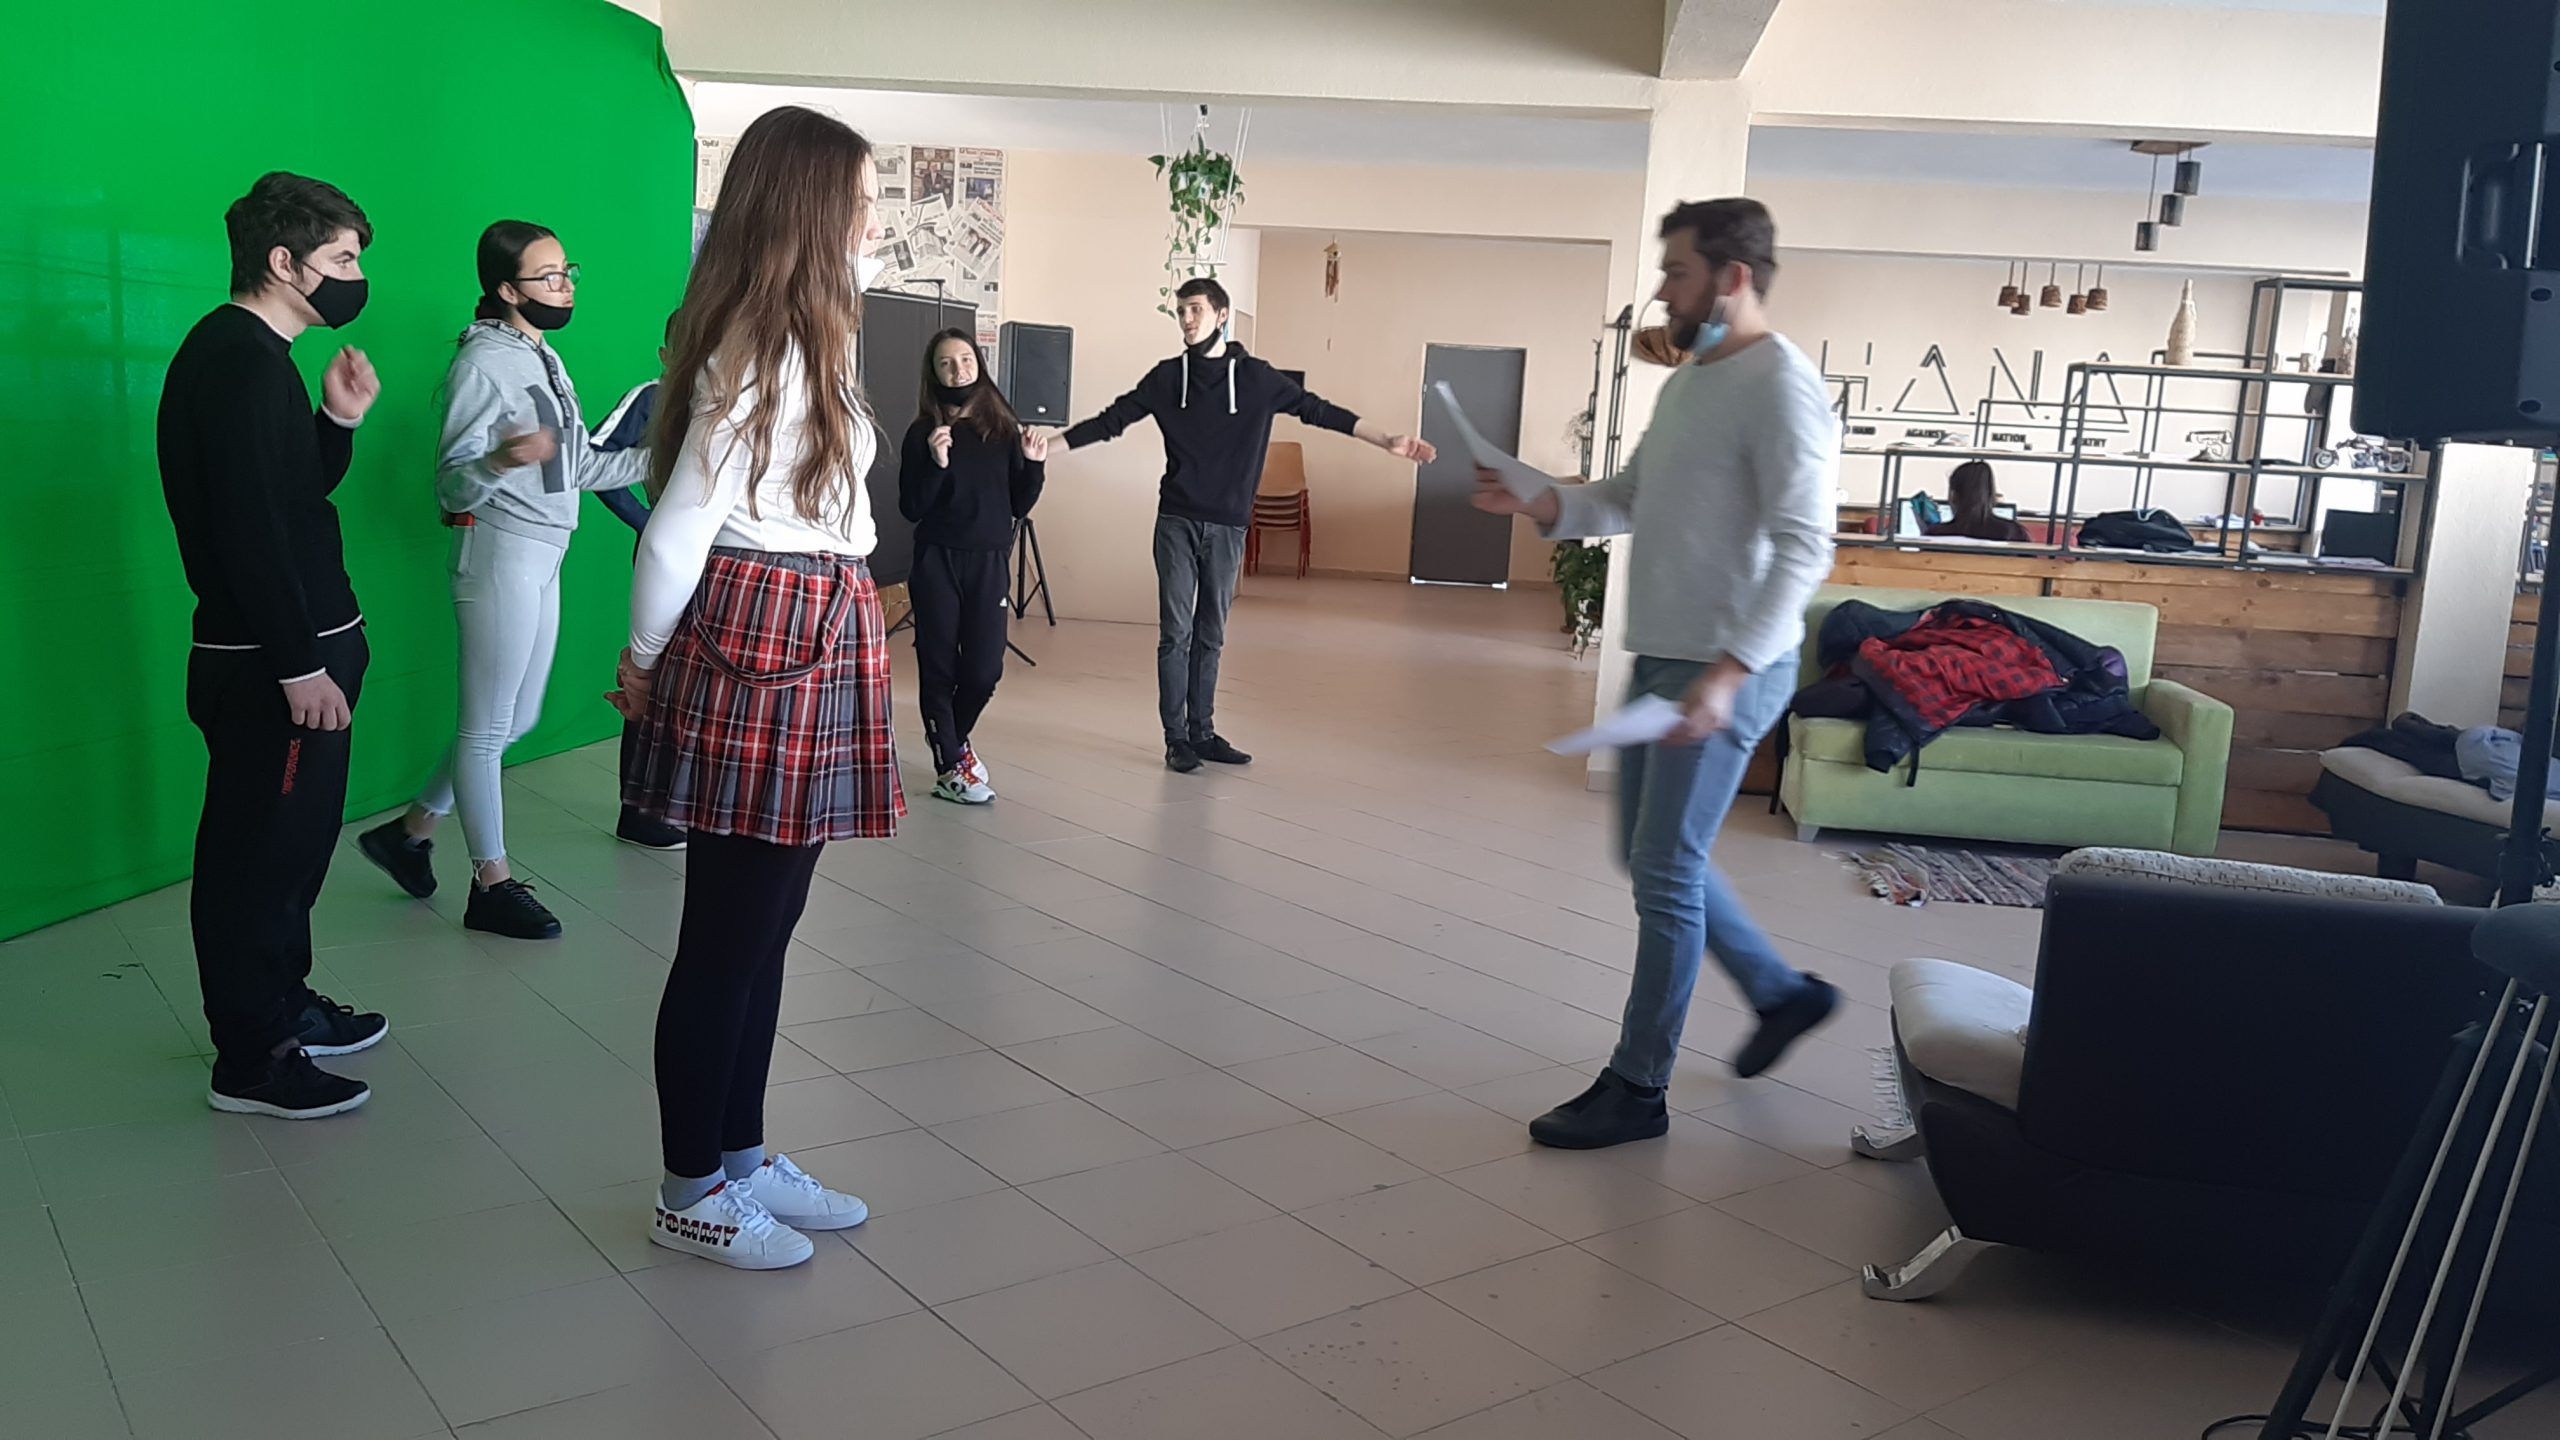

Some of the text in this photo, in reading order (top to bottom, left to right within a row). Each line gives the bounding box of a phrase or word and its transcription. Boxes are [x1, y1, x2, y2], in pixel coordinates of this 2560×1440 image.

[1991, 432, 2027, 444] NATION
[2070, 436, 2108, 448] AATHY
[655, 1206, 740, 1248] TOMMY
